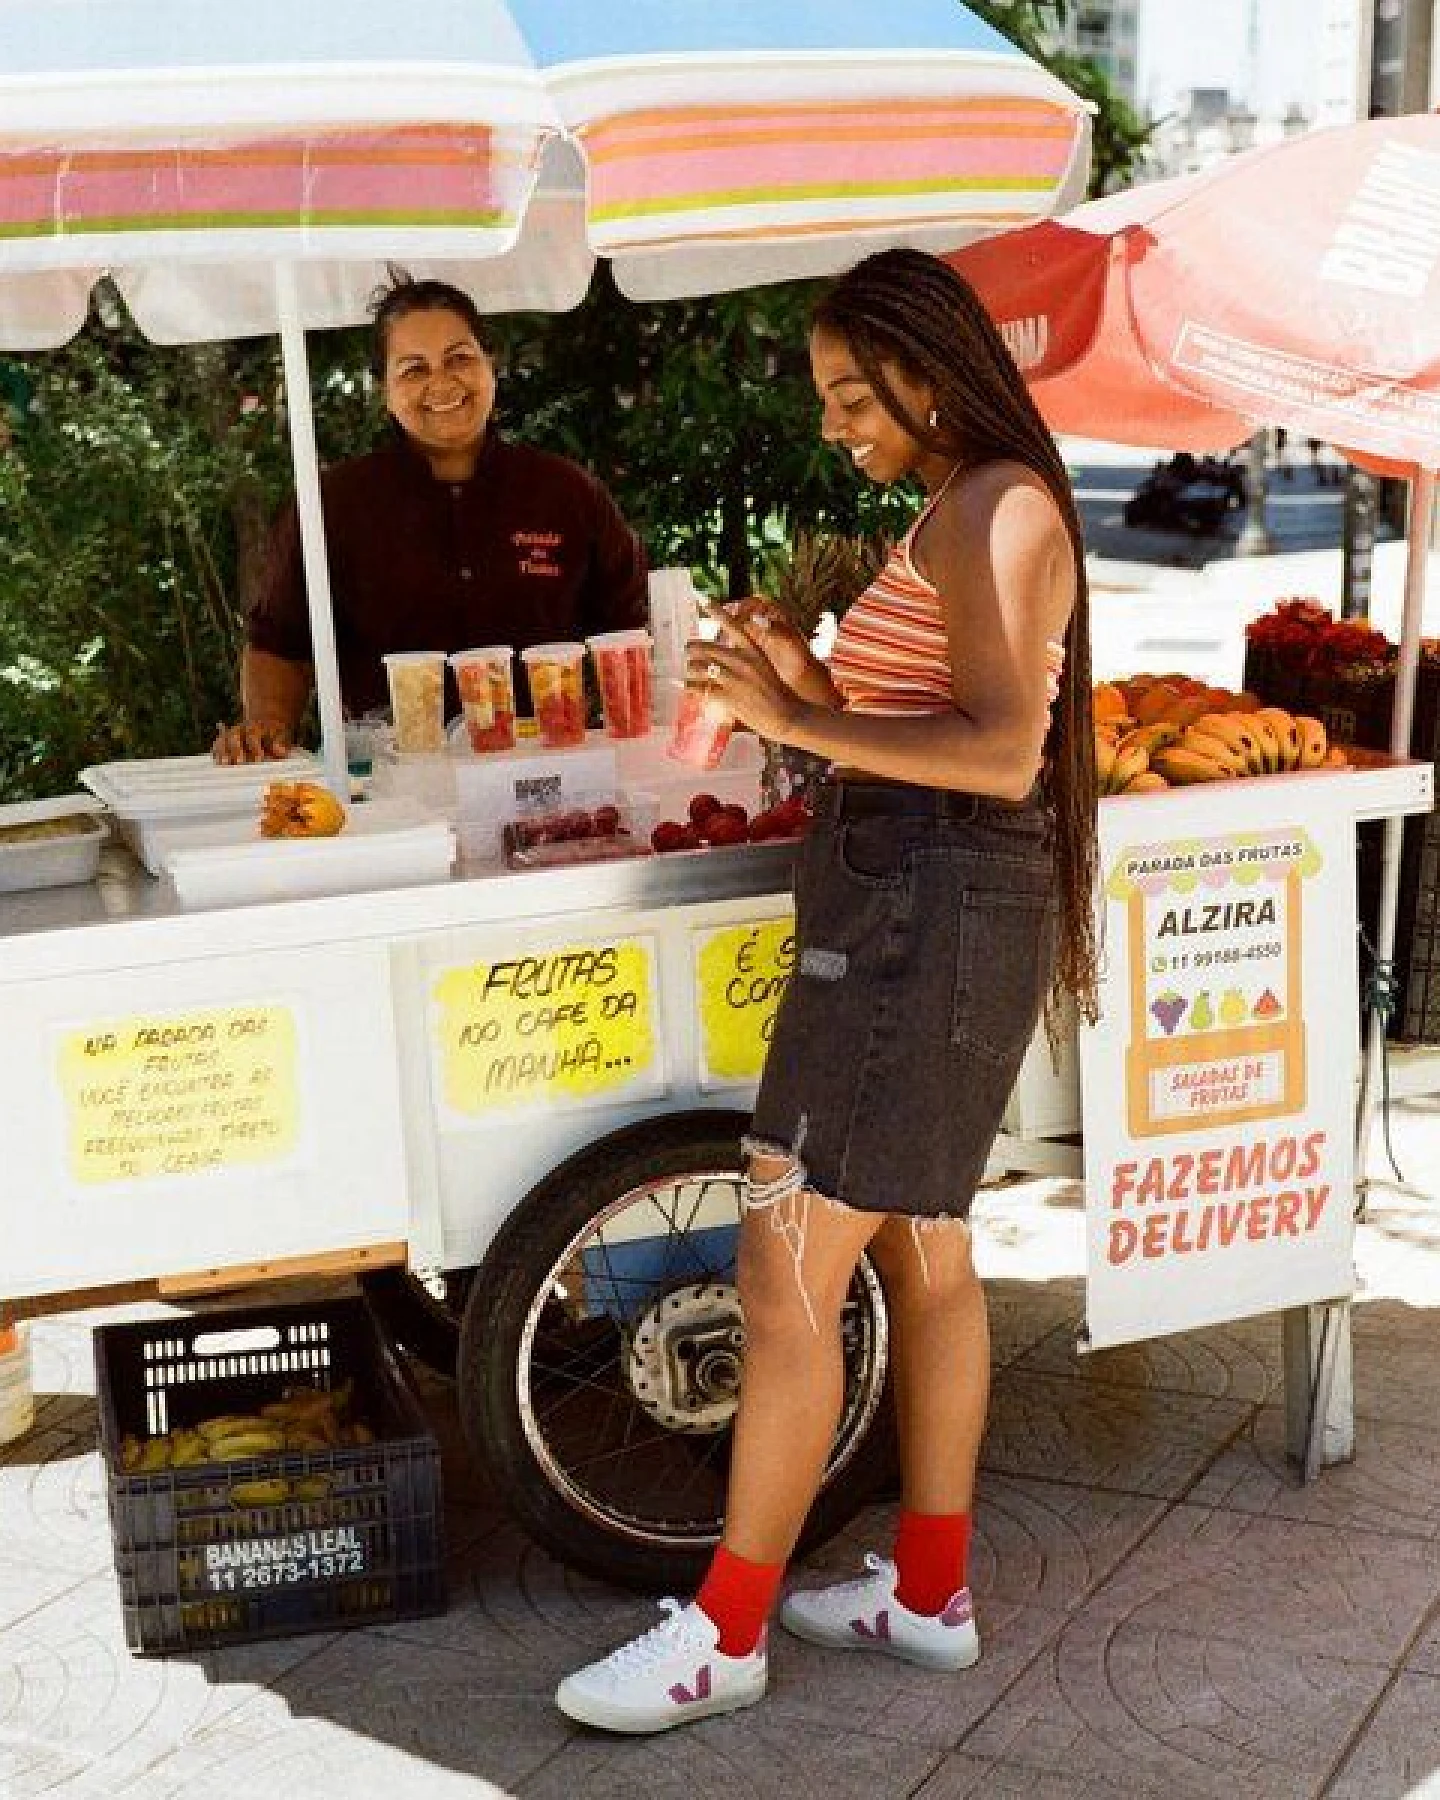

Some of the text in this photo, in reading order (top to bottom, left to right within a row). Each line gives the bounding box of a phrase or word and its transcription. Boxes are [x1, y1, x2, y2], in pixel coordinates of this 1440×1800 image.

[1127, 842, 1303, 875] PARADA DAS FRUTAS
[1157, 898, 1277, 939] ALZIRA
[480, 948, 617, 1002] FRUTAS
[600, 990, 637, 1020] DA
[1112, 1131, 1327, 1209] FAZEMOS
[1106, 1184, 1332, 1267] DELIVERY
[206, 1526, 361, 1570] BANANAS LEAL
[209, 1570, 235, 1591] 11
